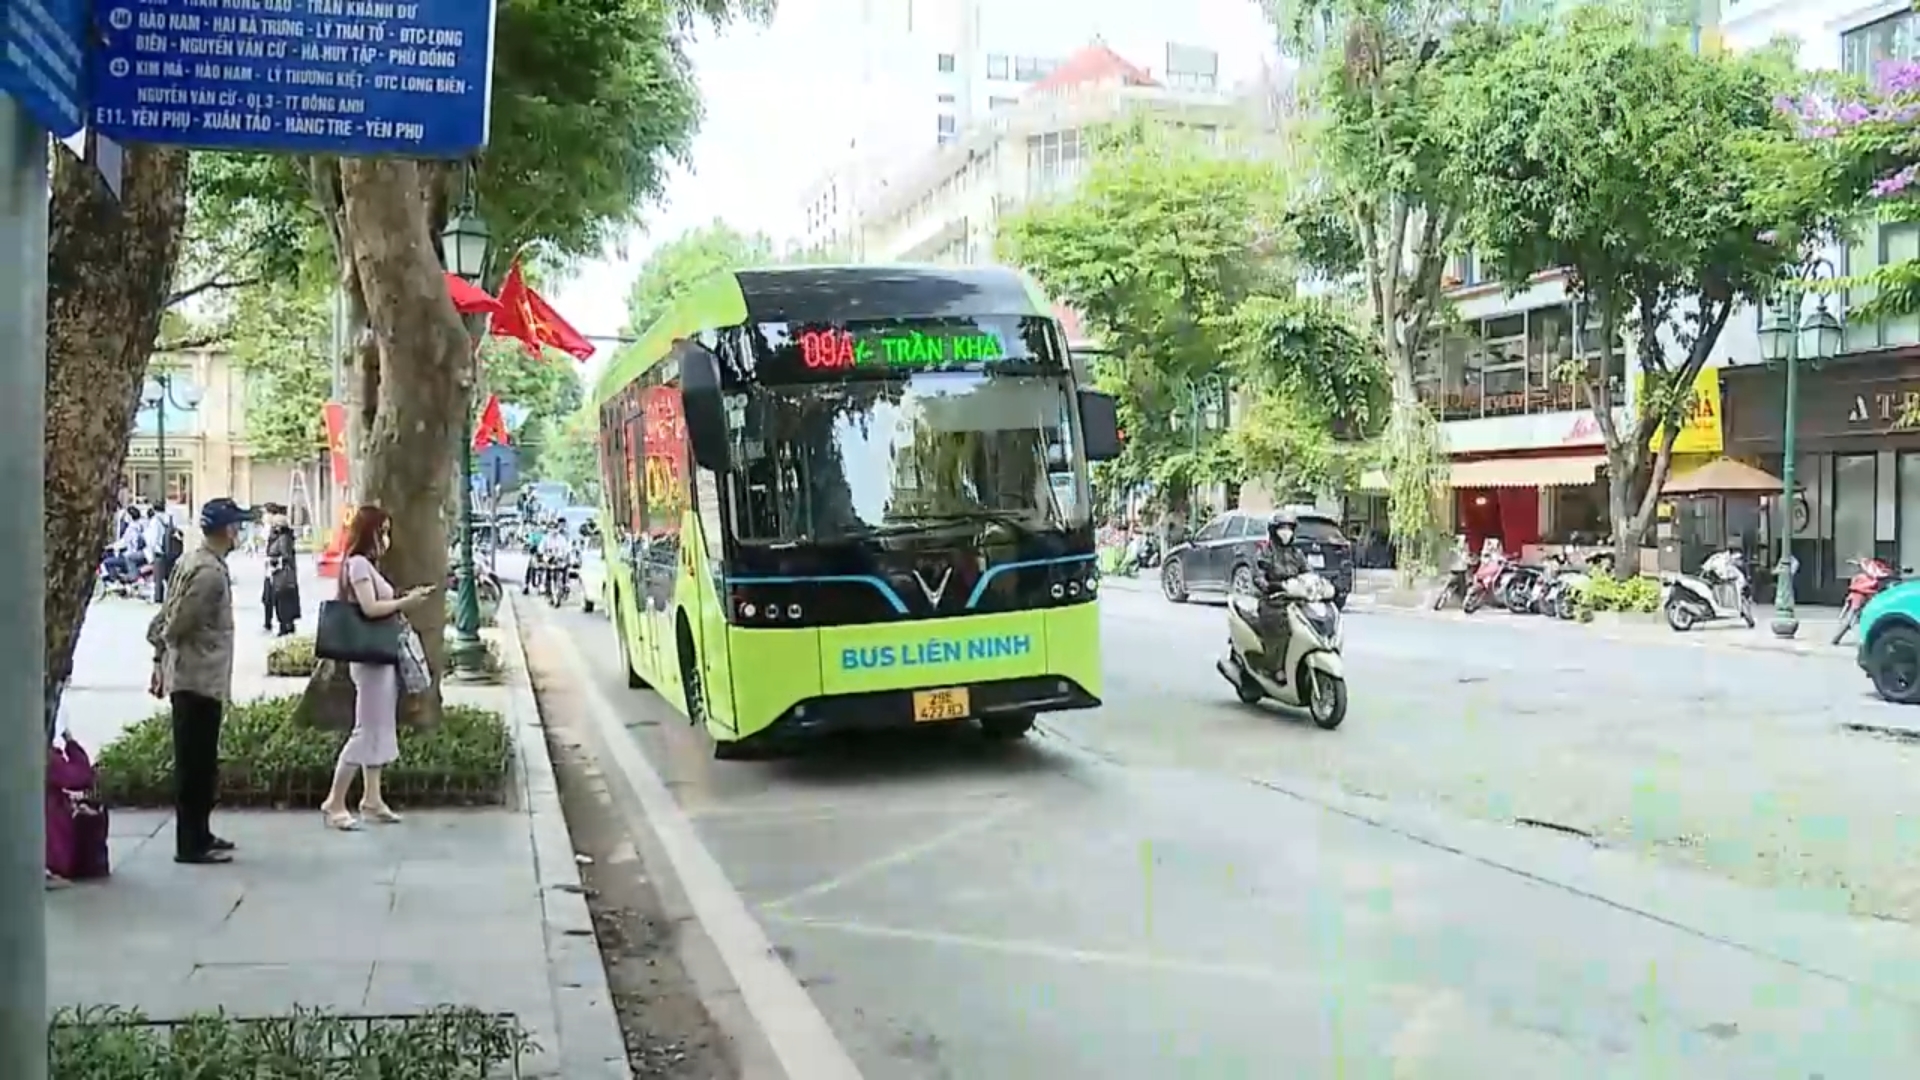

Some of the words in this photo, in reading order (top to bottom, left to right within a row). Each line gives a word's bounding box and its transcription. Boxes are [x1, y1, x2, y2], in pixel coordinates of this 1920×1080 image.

[168, 13, 200, 32] NAM
[212, 15, 235, 34] HAI
[136, 61, 160, 76] KIM
[223, 65, 252, 81] NAM
[401, 76, 434, 93] LONG
[338, 98, 365, 113] ANH
[327, 118, 352, 136] TRE
[842, 646, 896, 670] BUS
[901, 638, 961, 665] LIÊN
[966, 635, 1029, 659] NINH
